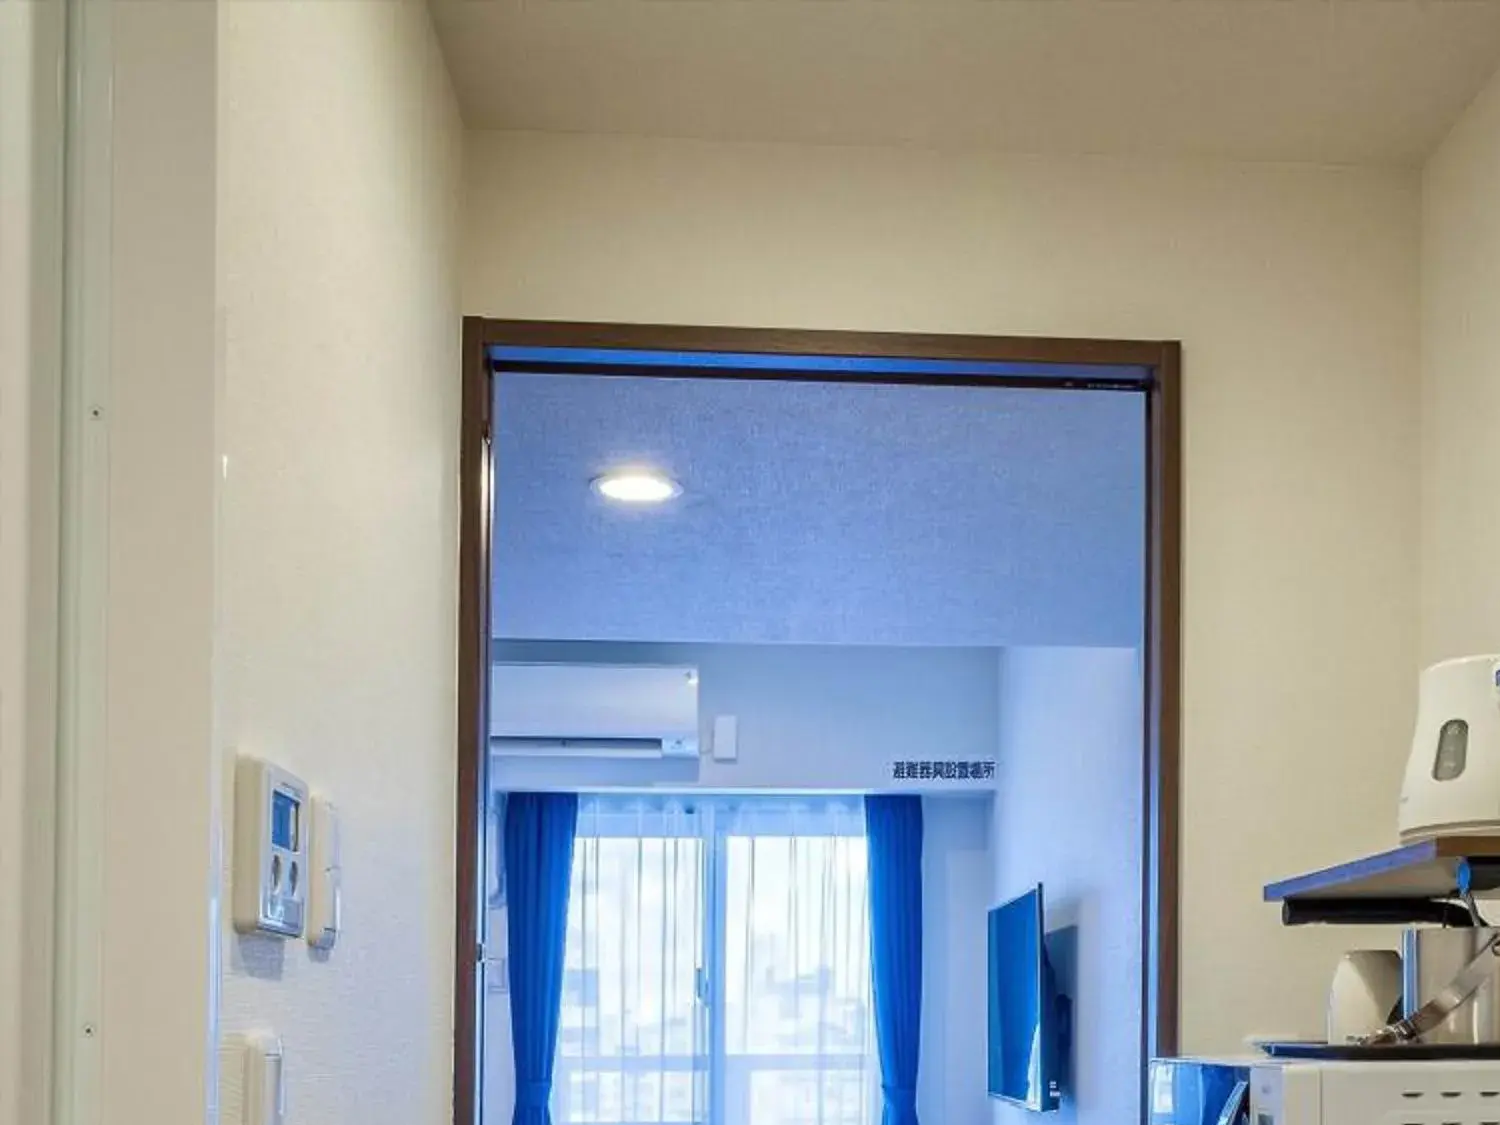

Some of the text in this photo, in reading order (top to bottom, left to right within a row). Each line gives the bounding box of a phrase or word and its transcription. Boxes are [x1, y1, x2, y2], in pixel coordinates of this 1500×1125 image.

[893, 761, 996, 779] 避難器具設置場所
